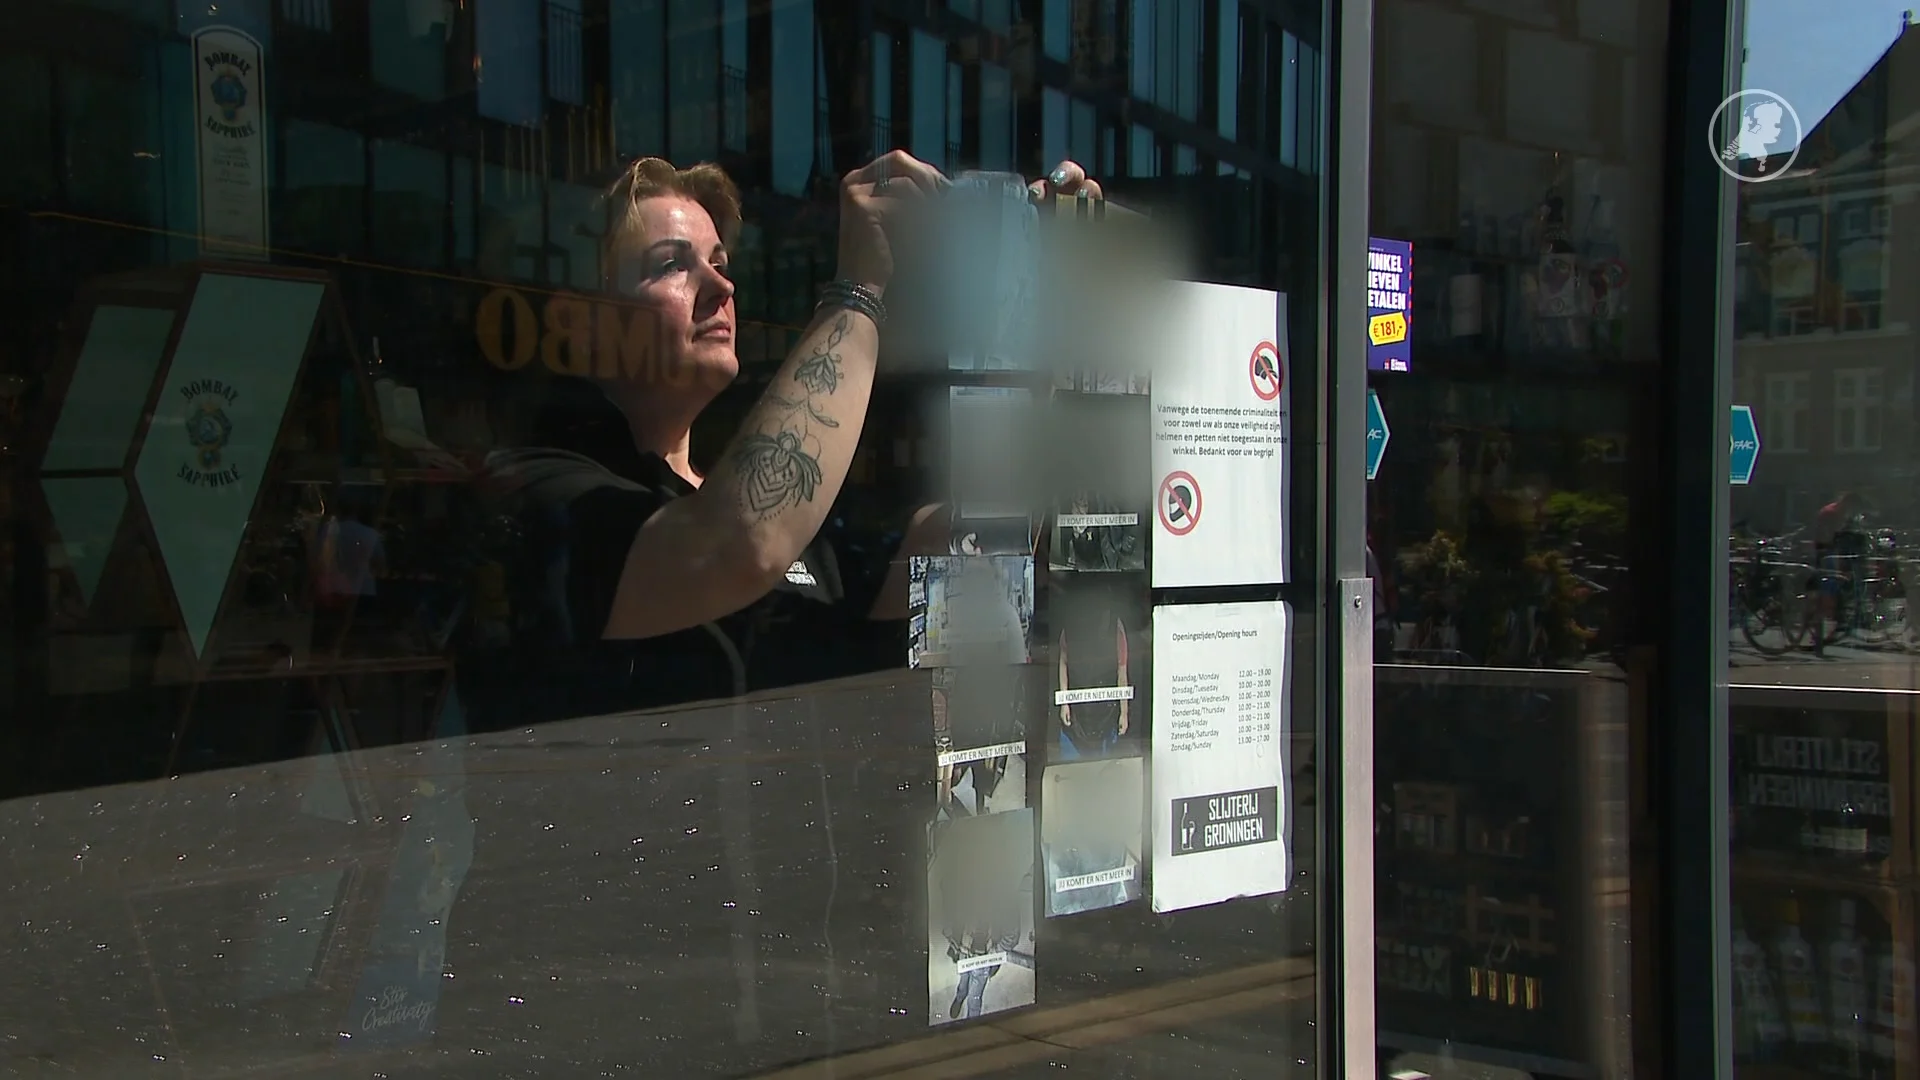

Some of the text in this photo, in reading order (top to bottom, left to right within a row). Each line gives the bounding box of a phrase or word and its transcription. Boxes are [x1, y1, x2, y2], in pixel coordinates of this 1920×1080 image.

[205, 52, 252, 77] BOMBAY
[205, 115, 257, 139] SAPPHIRE
[1368, 252, 1403, 272] INKEL
[1368, 289, 1406, 310] ETALEN
[180, 379, 239, 406] BOMBAY
[1157, 405, 1189, 416] Vanwege
[1191, 405, 1199, 414] de
[1201, 406, 1241, 415] toenemende
[1242, 407, 1277, 417] criminaliteit
[1182, 420, 1201, 428] zowel
[1214, 420, 1222, 428] als
[1241, 421, 1268, 432] veiligheid
[1156, 432, 1182, 441] helmen
[1195, 434, 1216, 443] petten
[1218, 434, 1229, 442] niet
[1231, 435, 1264, 444] toegestaan
[1367, 428, 1382, 440] AC
[1734, 440, 1754, 450] FAAC
[1199, 448, 1225, 456] Bedankt
[1254, 448, 1274, 458] begrip!
[177, 461, 241, 487] SAPPHIRE
[1066, 517, 1084, 525] KOMT
[1109, 516, 1126, 524] MEER
[1242, 629, 1257, 637] hours
[1172, 673, 1219, 682] Maandag/Monday
[1257, 677, 1271, 687] 20.00
[1084, 692, 1091, 700] ER
[1107, 690, 1122, 698] MEER
[1172, 694, 1230, 705] Woensdag/Wednesday
[1257, 688, 1271, 698] 20.00
[1172, 706, 1225, 717] Donderdag/Thursday
[1239, 703, 1252, 711] 10.00
[1171, 718, 1208, 729] Vrijdag/Friday
[1239, 714, 1252, 722] 10.00
[1171, 728, 1219, 740] Zaterdag/Saturday
[1239, 725, 1252, 733] 10.00
[948, 753, 967, 762] KOMT
[968, 751, 977, 759] ER
[978, 749, 993, 758] NIET
[994, 746, 1013, 756] MEER
[1171, 741, 1212, 752] Zondag/Sunday
[1209, 792, 1258, 821] SLIJTERIJ
[1204, 817, 1264, 847] GRONINGEN
[1067, 878, 1085, 887] KOMT
[1087, 876, 1094, 884] ER
[1095, 874, 1108, 882] NIET
[1109, 871, 1124, 879] MEER
[362, 1000, 436, 1031] Creativity
